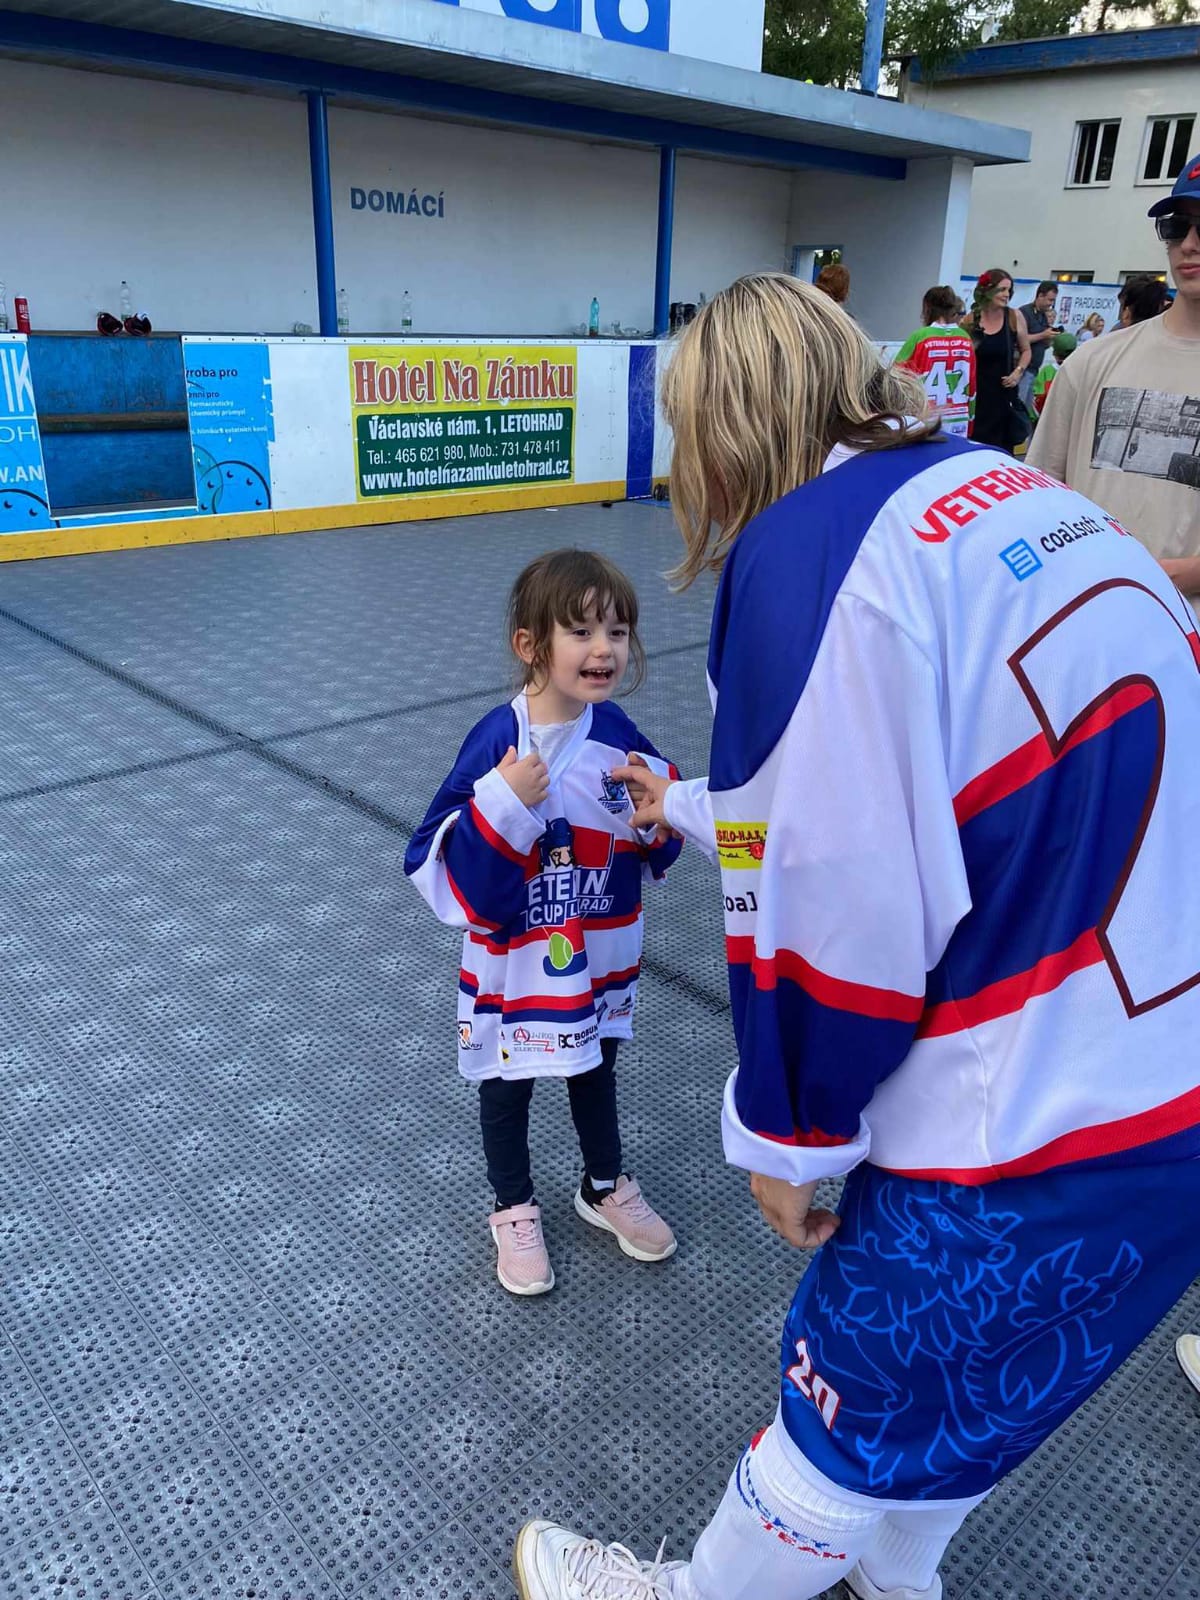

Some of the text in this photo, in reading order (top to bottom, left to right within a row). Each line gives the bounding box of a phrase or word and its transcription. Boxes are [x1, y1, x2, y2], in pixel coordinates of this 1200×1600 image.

[351, 187, 444, 218] DOMÁCÍ
[219, 369, 238, 380] pro
[353, 357, 574, 404] Hotel Na Zámku
[925, 361, 970, 405] 42
[369, 412, 564, 440] Václavské nám. 1, LETOHRAD
[367, 439, 560, 465] Tel.: 465 621 980, Mob.: 731 478 411
[362, 459, 570, 491] www.hotelnazamkuletohrad.cz
[529, 903, 563, 925] CUP
[785, 1338, 841, 1430] 20
[760, 1516, 847, 1560] TEAM
